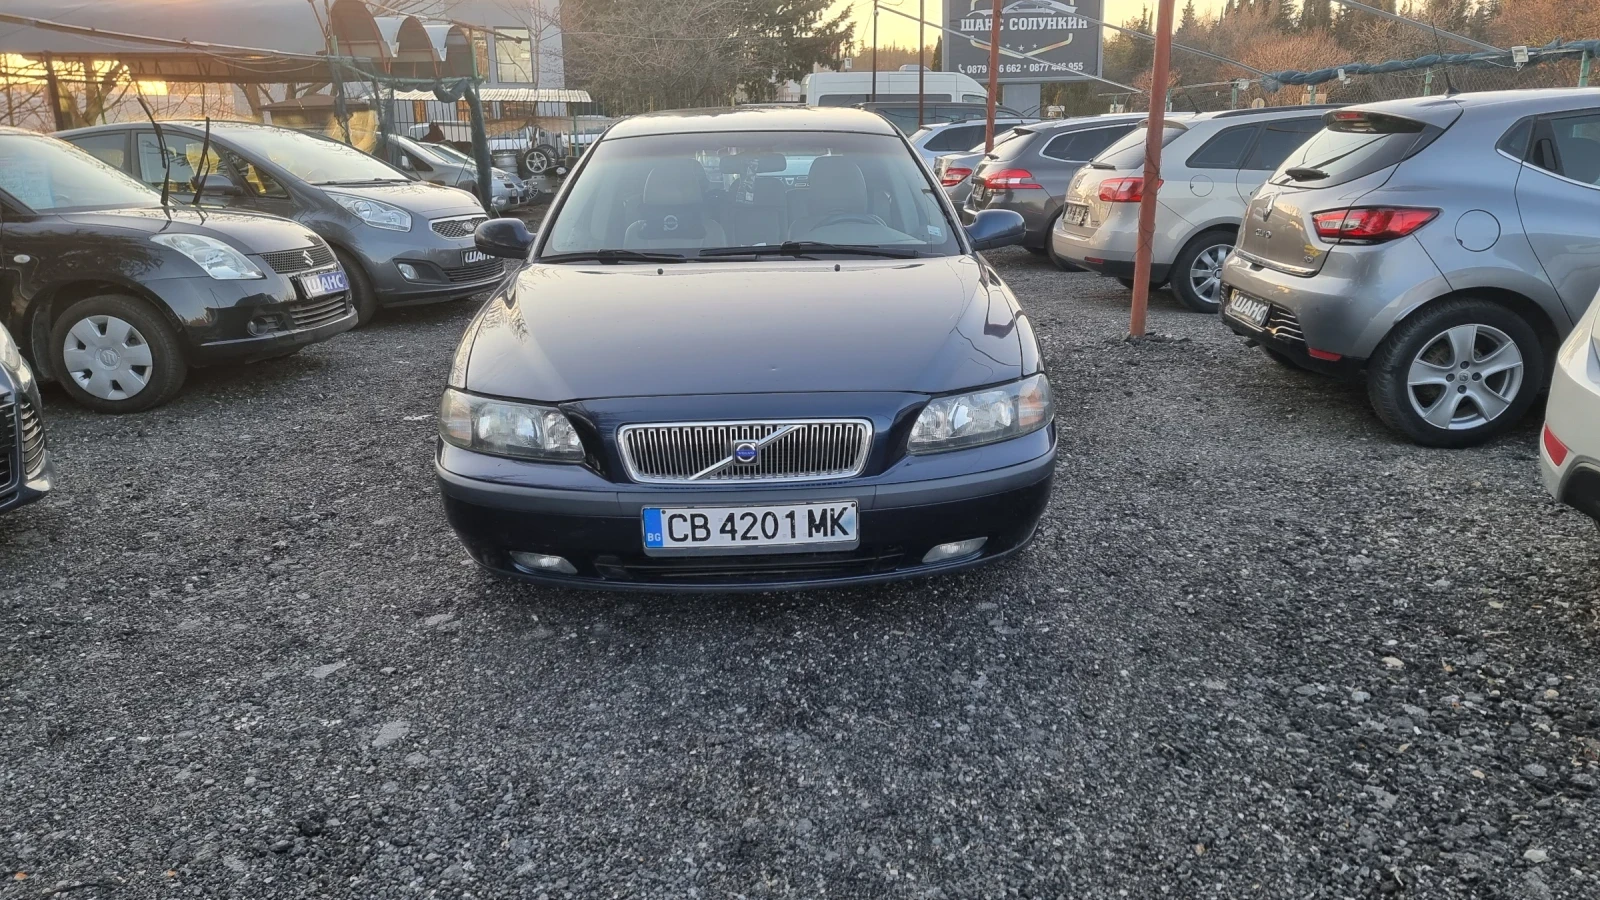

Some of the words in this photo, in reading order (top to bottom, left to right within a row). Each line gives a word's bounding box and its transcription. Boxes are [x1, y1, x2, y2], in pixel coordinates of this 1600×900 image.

[1009, 16, 1088, 31] СОЛУНКИН
[967, 65, 987, 74] 0879
[1006, 64, 1021, 73] 662
[1029, 63, 1049, 72] 0877
[1068, 62, 1084, 71] 955
[1231, 294, 1268, 321] ШАНС
[719, 510, 797, 541] 4201
[807, 506, 850, 538] MK
[647, 532, 661, 542] BG
